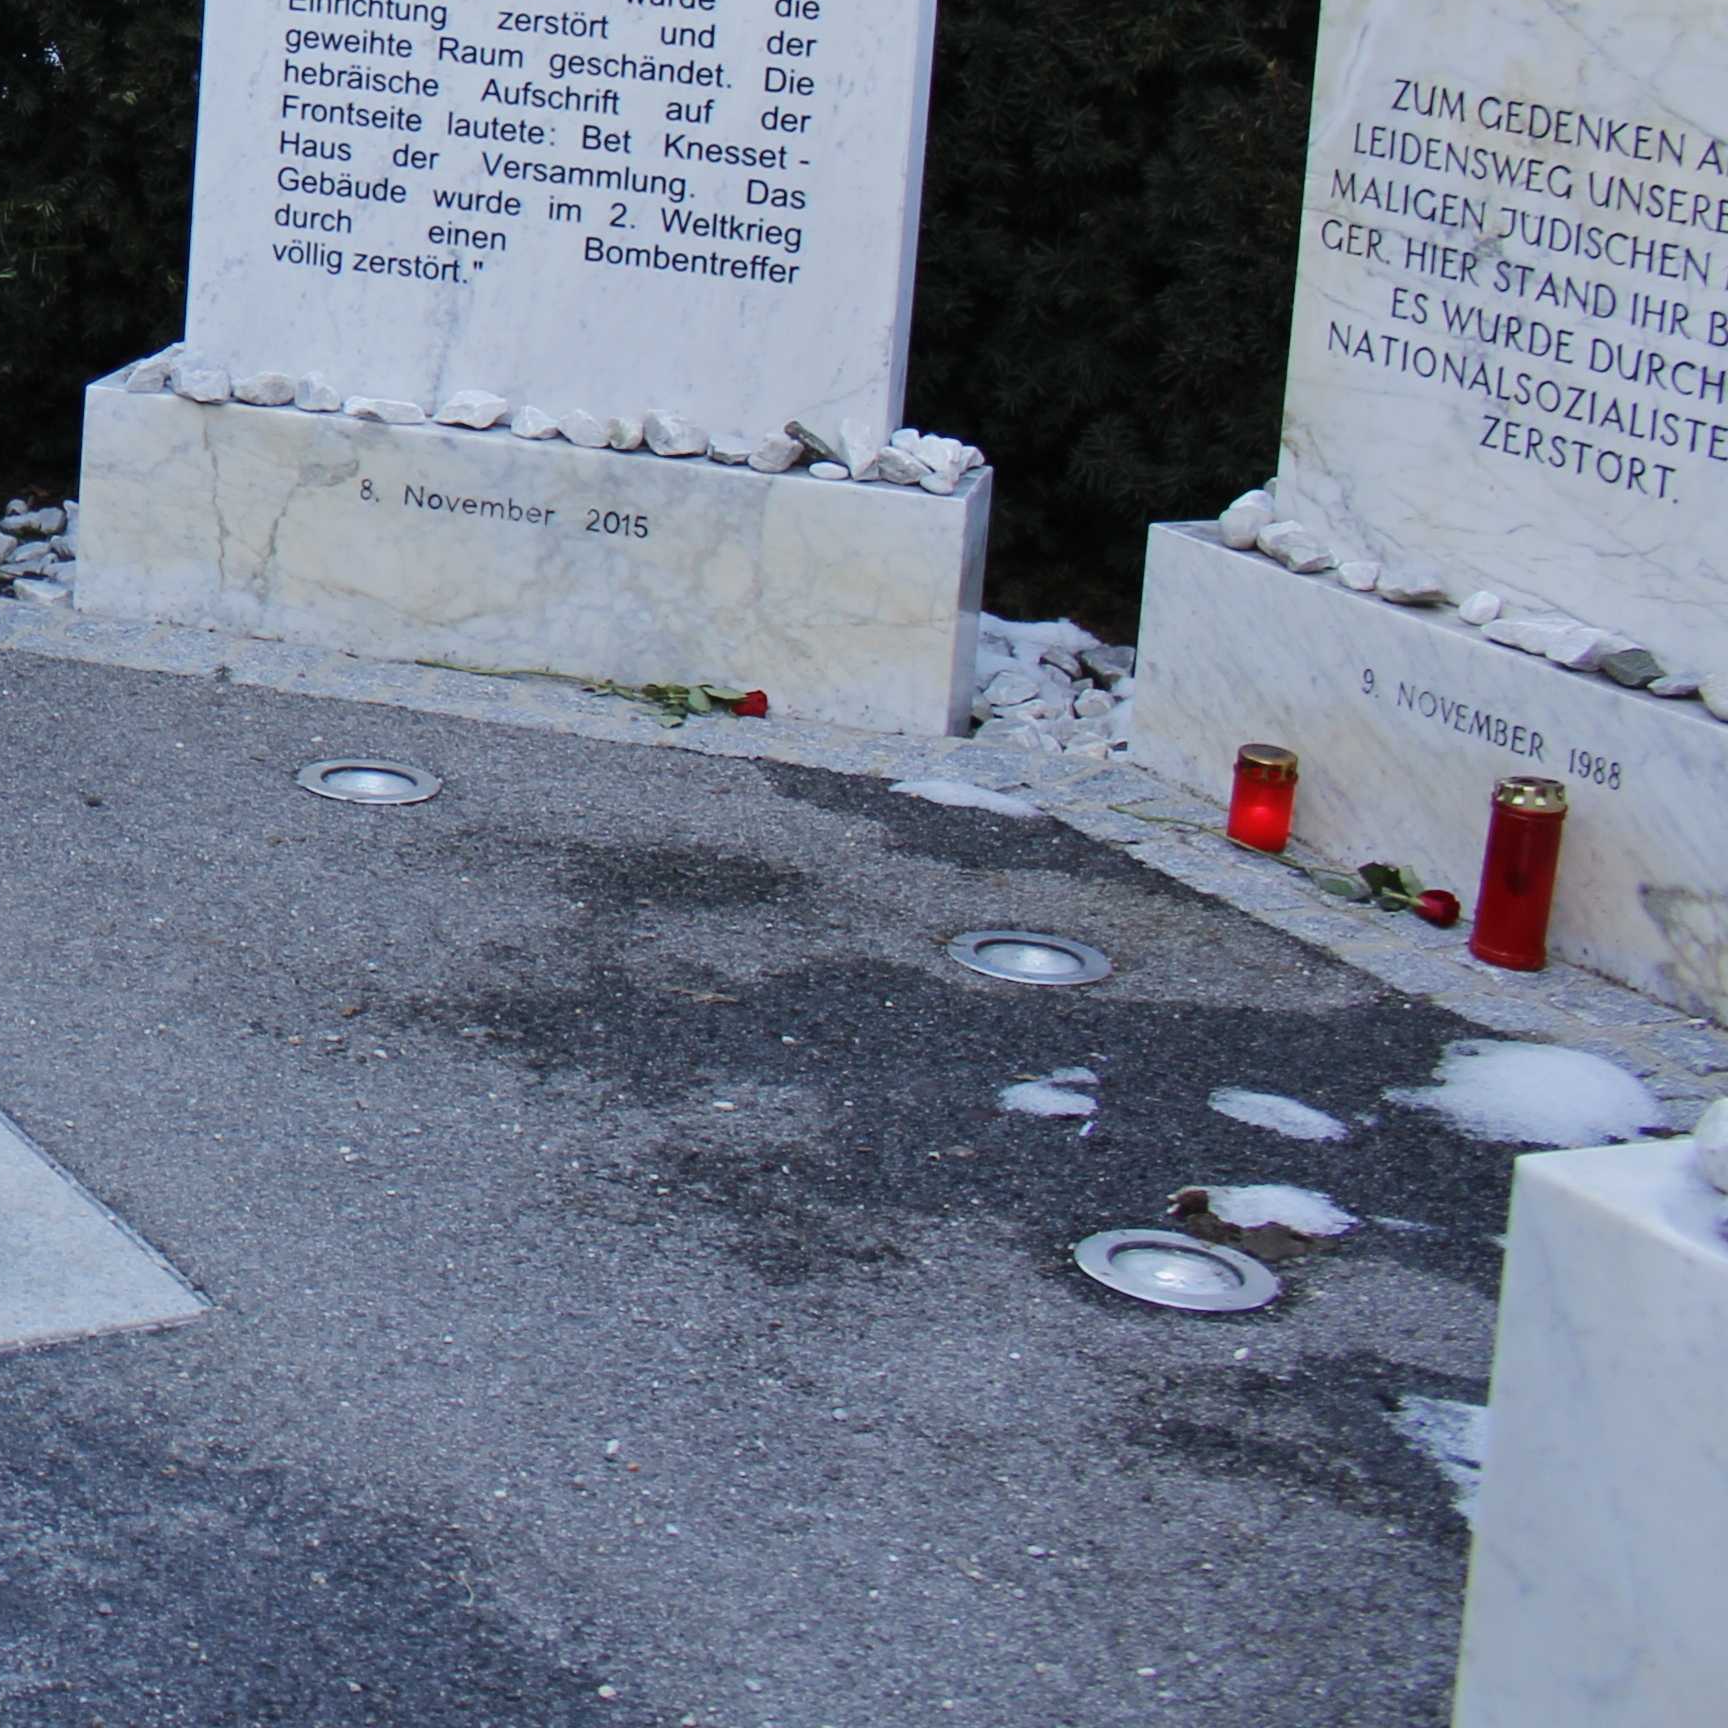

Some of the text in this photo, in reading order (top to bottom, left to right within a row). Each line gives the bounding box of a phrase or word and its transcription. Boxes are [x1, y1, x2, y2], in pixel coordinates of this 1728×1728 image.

[284, 28, 815, 97] geweihte Raum geschändet. Die
[496, 11, 610, 40] zerstört
[660, 23, 717, 50] und
[765, 29, 819, 58] der
[281, 93, 423, 133] Frontseite
[447, 110, 556, 147] lautete:
[581, 123, 633, 155] Bet
[663, 132, 788, 171] Knesset
[283, 57, 813, 134] hebräische Aufschrift auf der
[1391, 78, 1728, 178] ZUM GEDENKEN A
[279, 129, 807, 211] Haus der Versammlung. Das
[1353, 122, 1573, 200] LEIDENSWEG
[274, 202, 801, 285] durch einen Bombentreffer
[276, 165, 803, 254] Gebäude wurde im 2. Weltkrieg
[1330, 168, 1711, 287] MALIGEN JÜDISCHEN
[271, 238, 344, 276] völlig
[1321, 219, 1392, 266] GER.
[1404, 236, 1479, 287] HIER
[1494, 260, 1617, 319] STAND
[1630, 291, 1691, 340] IHR
[1391, 287, 1728, 405] ES WURDE DURCH
[1480, 414, 1679, 505] ZERSTÖRT.
[359, 478, 649, 539] 8. November 2015
[1361, 668, 1624, 791] 9. NOVEMBER 1988
